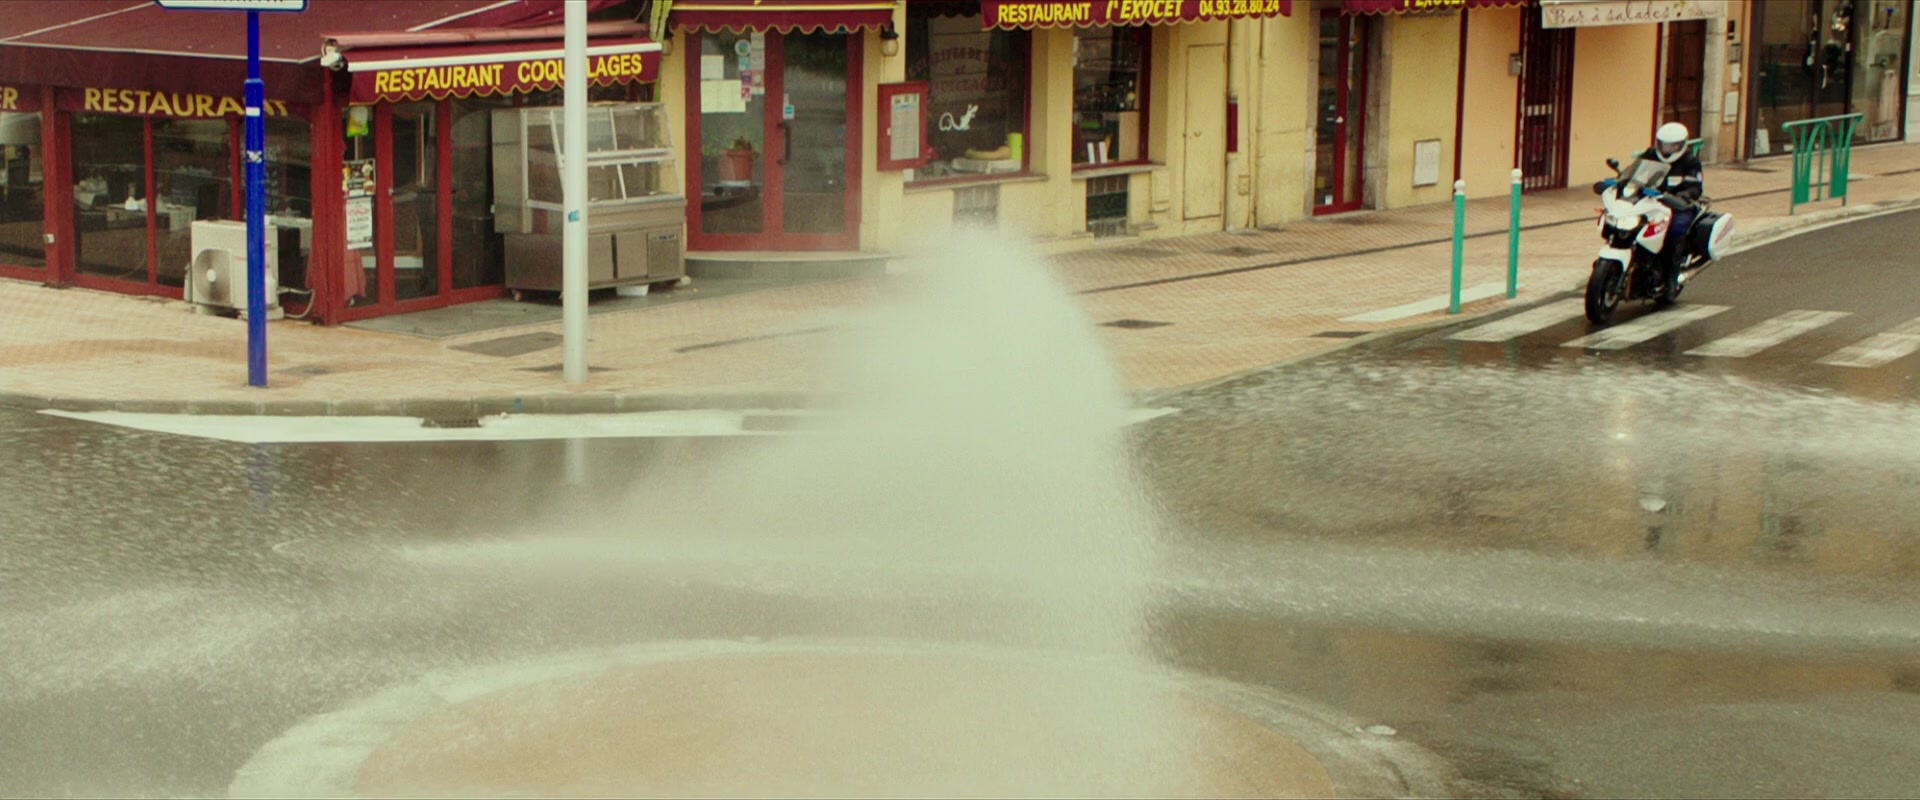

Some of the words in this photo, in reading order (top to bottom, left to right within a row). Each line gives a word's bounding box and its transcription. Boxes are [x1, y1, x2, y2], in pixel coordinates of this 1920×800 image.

[998, 2, 1091, 23] RESTAURANT
[1199, 0, 1280, 16] 04.93.28.80.24
[1550, 8, 1585, 25] Bar
[1591, 6, 1601, 22] à
[1606, 1, 1670, 22] salades
[375, 64, 504, 94] RESTAURANT
[0, 86, 19, 111] R
